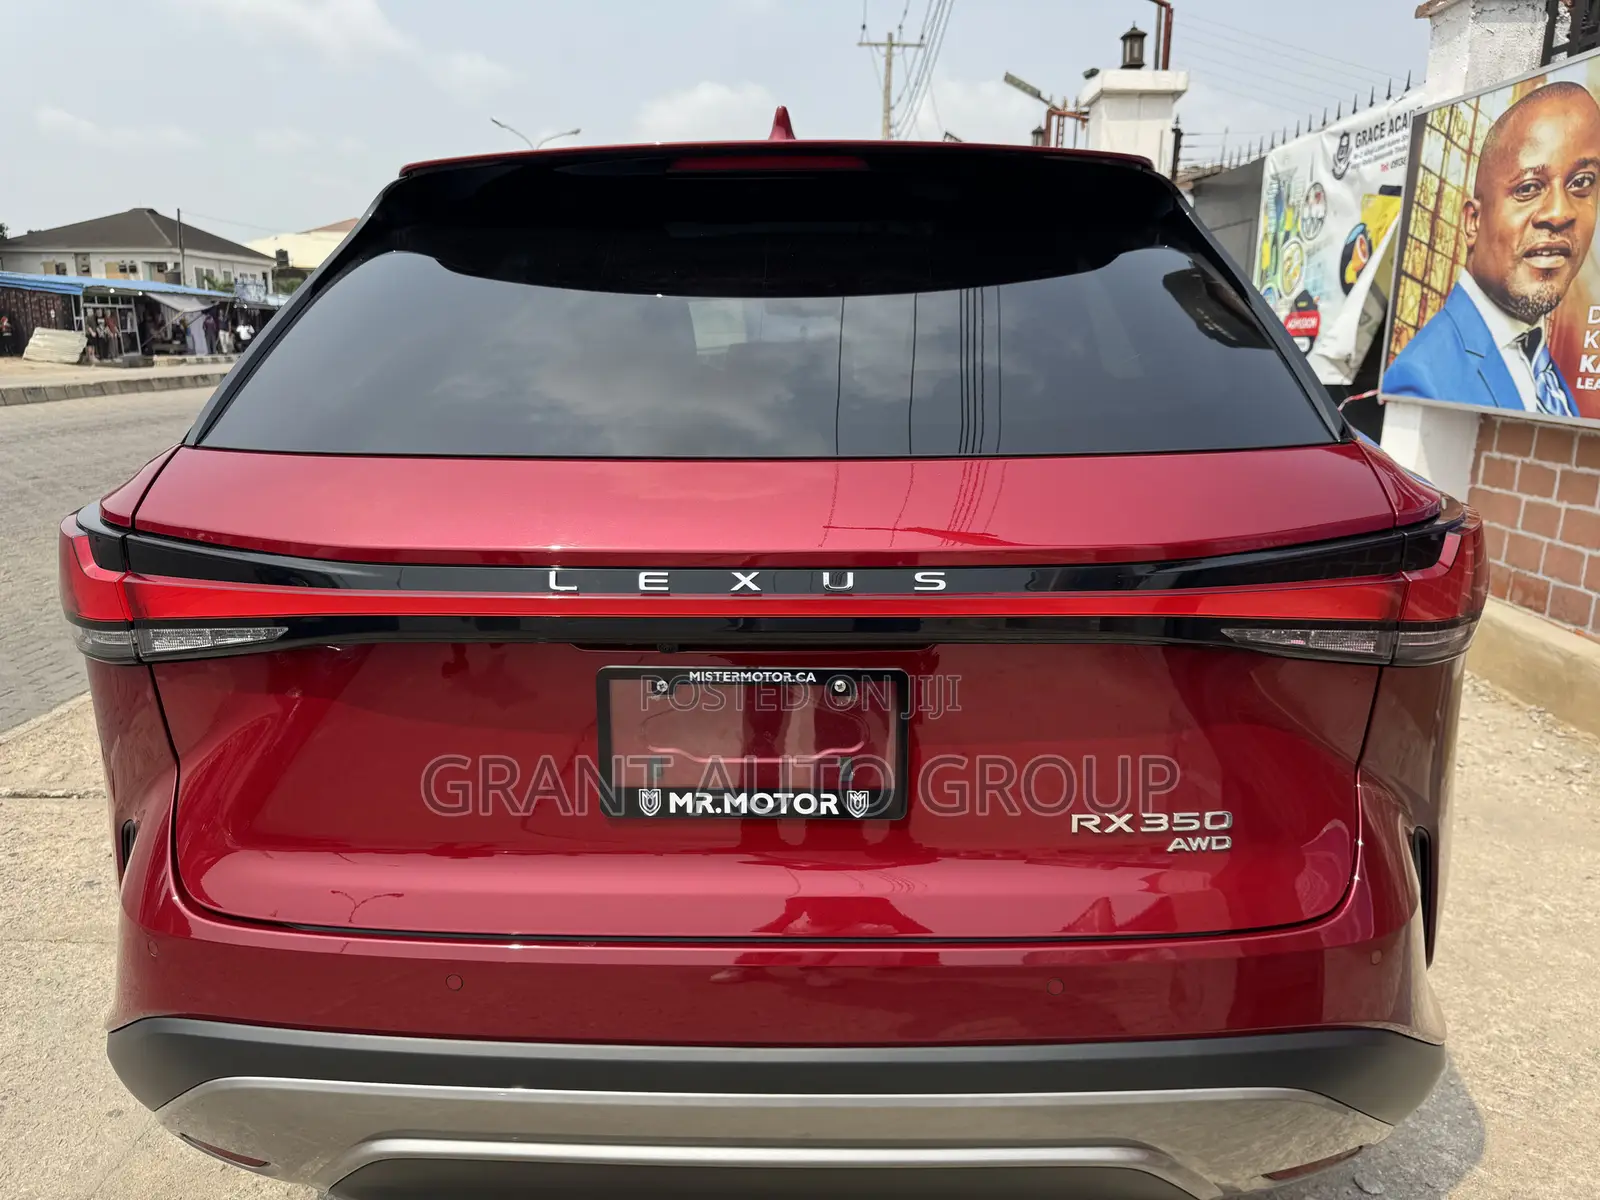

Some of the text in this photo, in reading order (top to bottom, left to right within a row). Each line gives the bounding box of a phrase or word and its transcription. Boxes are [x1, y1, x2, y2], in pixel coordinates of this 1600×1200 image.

[1355, 121, 1385, 148] GRACE
[548, 570, 947, 592] LEXUS
[689, 671, 816, 683] MISTERMOTOR.CA
[669, 792, 840, 816] MR.MOTOR
[1166, 836, 1233, 852] AWD
